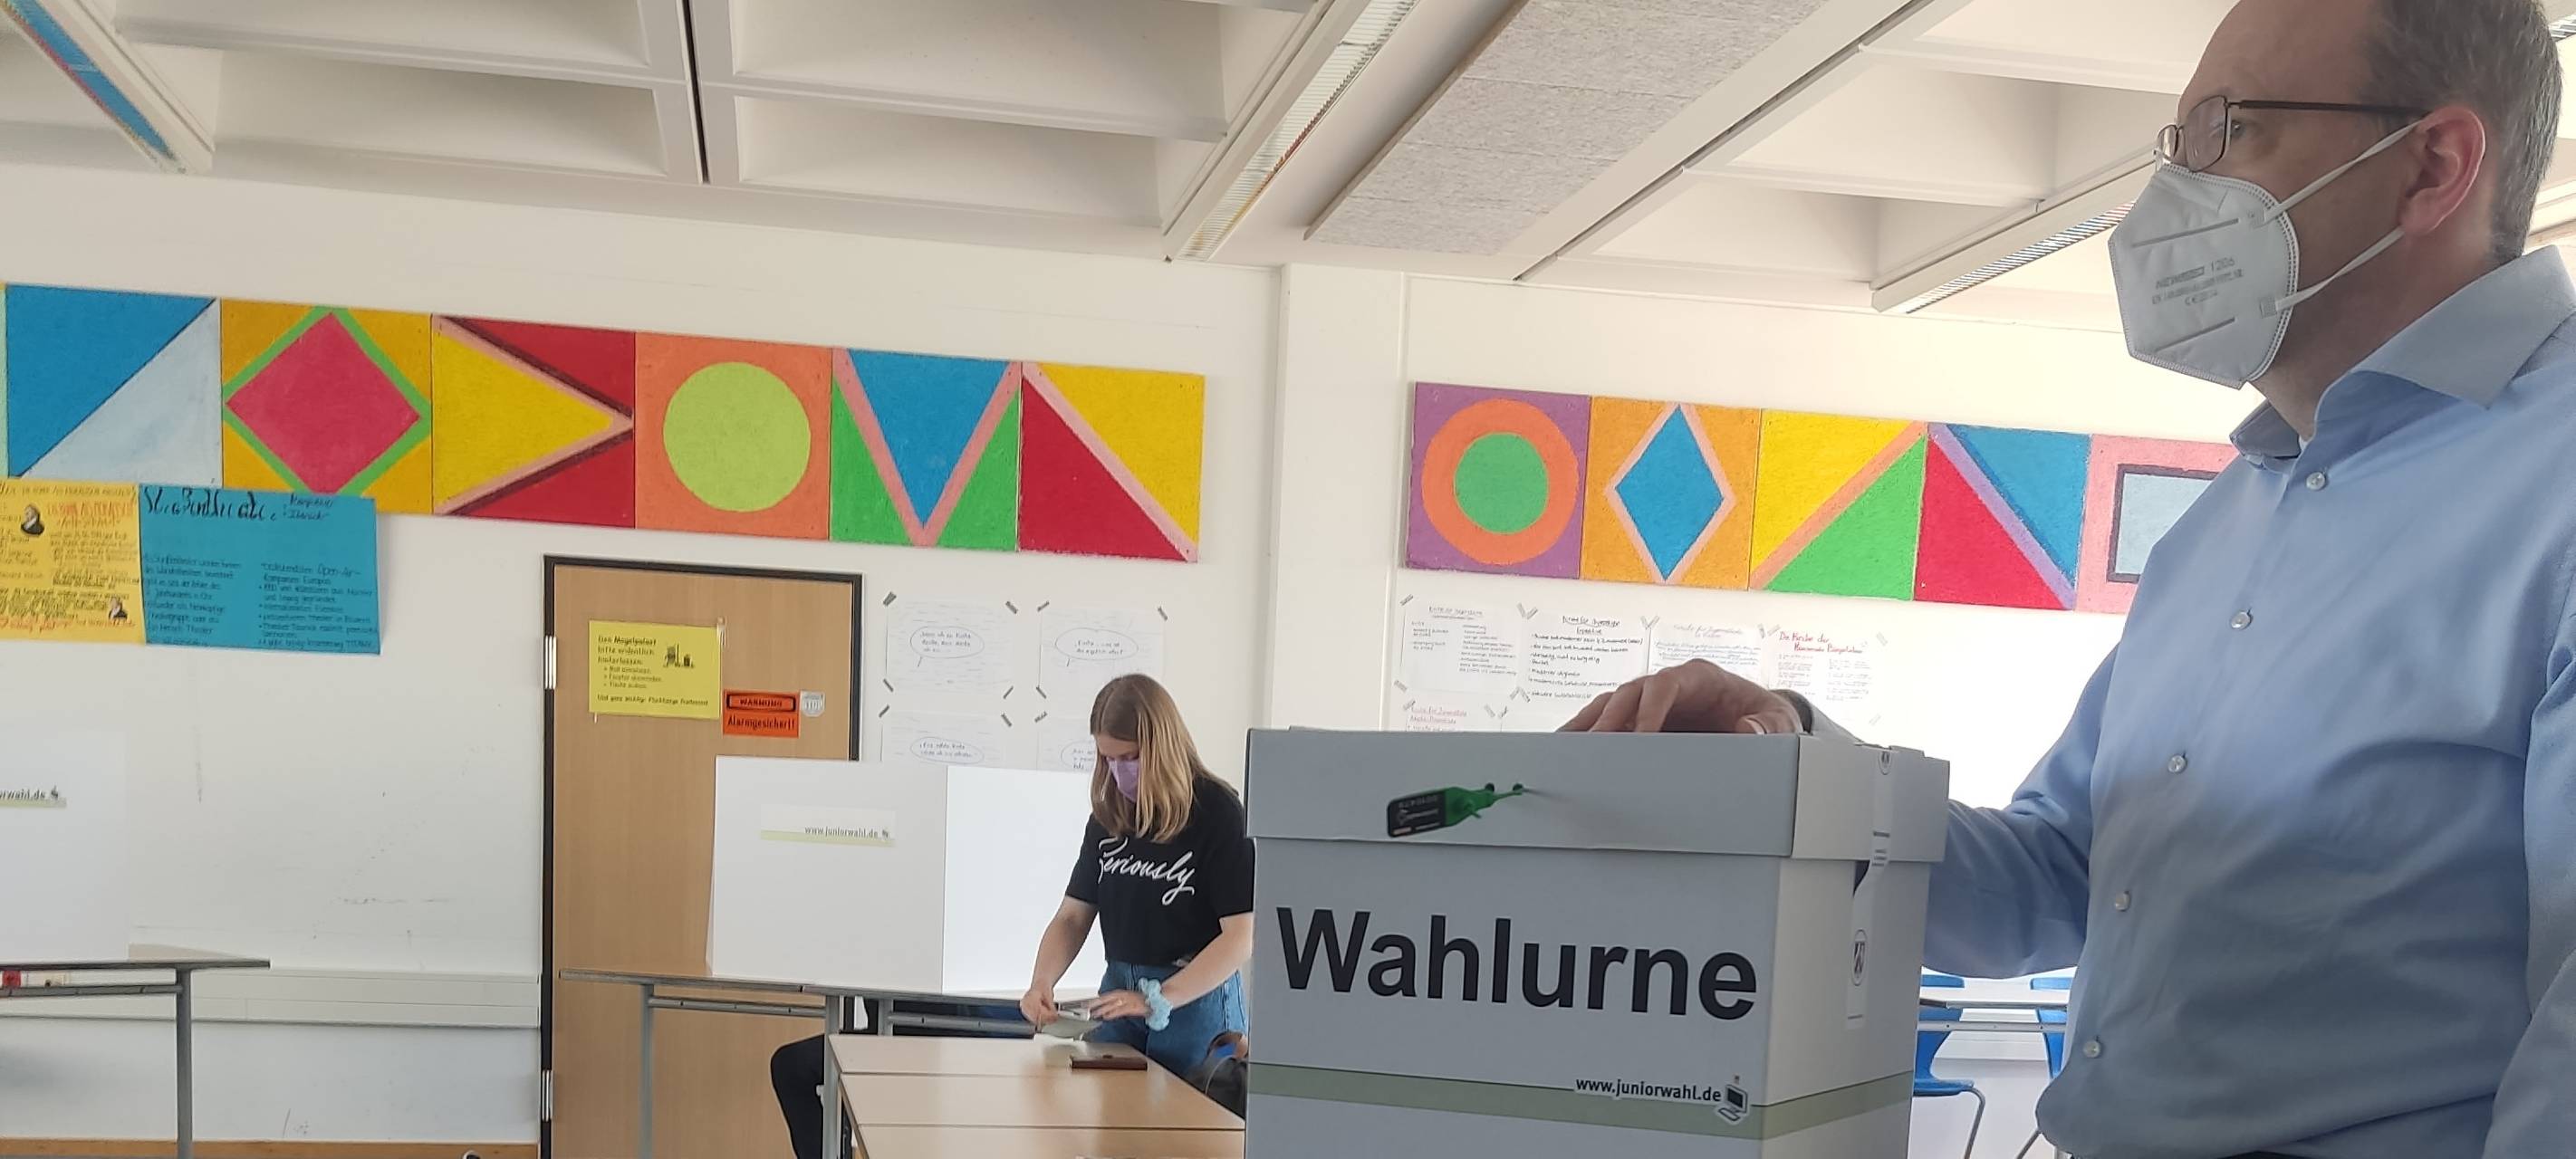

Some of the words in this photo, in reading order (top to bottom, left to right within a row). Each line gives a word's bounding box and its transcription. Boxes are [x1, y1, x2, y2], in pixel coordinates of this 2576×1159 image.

[739, 697, 783, 707] WARNUNG
[804, 825, 879, 838] www.juniorwahl.de
[1098, 835, 1196, 905] Seriously
[1277, 906, 1757, 1020] Wahlurne
[1576, 1078, 1721, 1103] www.juniorwahl.de
